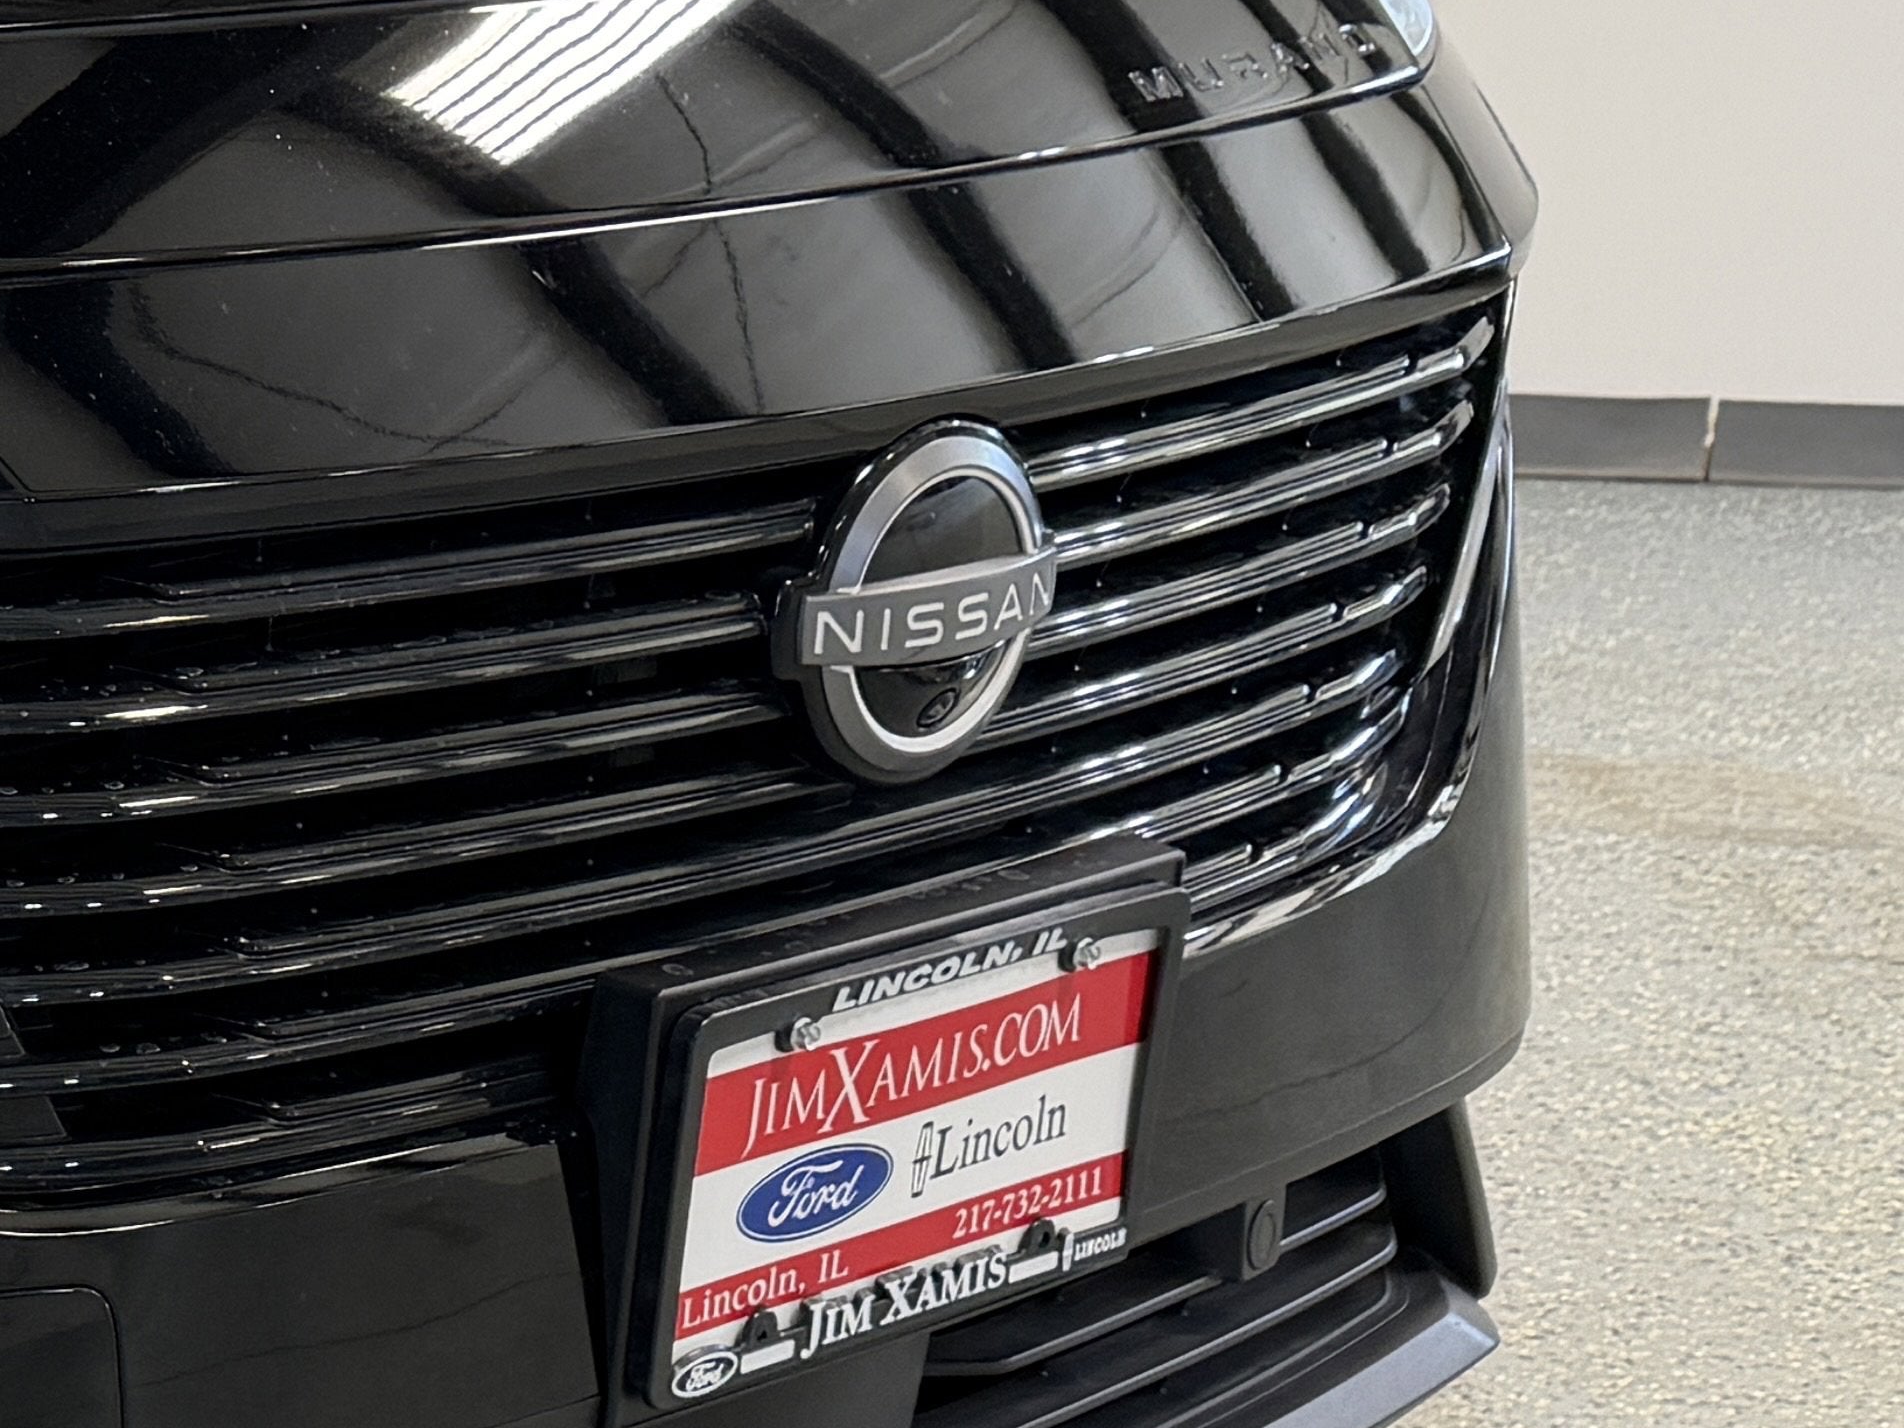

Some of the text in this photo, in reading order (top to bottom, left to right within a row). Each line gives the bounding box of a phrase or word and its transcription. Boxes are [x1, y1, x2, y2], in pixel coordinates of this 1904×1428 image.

[812, 571, 1052, 656] NISSAN
[831, 926, 1070, 1014] LINCOLN, IL
[741, 993, 1082, 1160] JIMXAMIS.COM
[930, 1094, 1069, 1182] Lincoln
[768, 1159, 866, 1228] Ford
[951, 1165, 1104, 1241] 217-732-2111
[680, 1249, 850, 1330] Lincoln, IL
[799, 1252, 1011, 1360] JIM XAMIS
